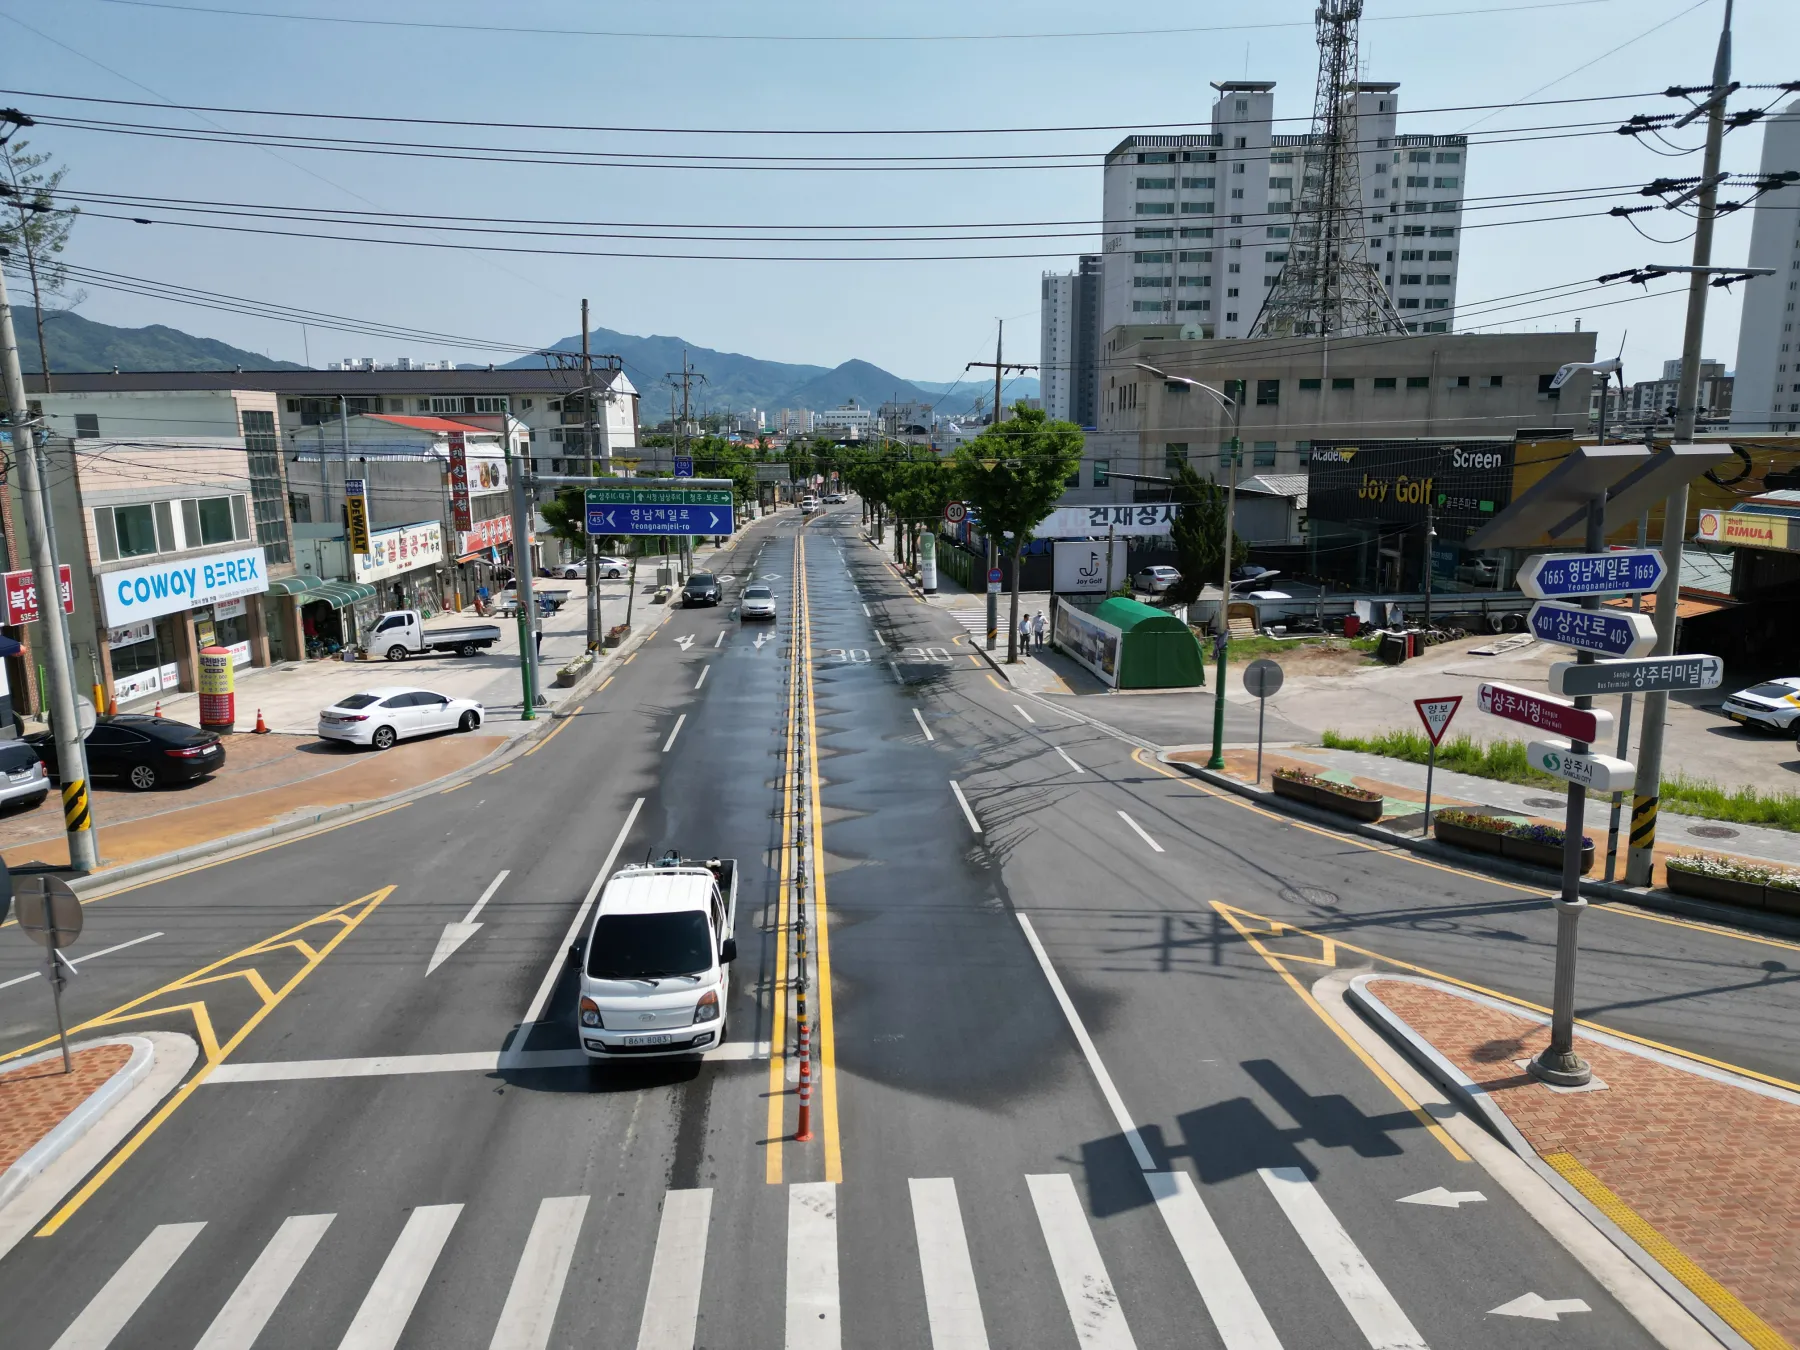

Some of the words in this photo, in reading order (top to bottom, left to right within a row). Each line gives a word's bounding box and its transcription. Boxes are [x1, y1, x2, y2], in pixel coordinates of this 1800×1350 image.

[1453, 448, 1502, 469] Screen
[1358, 473, 1389, 503] Joy
[1395, 475, 1433, 505] Golf
[630, 509, 690, 522] 영남제일로
[949, 507, 962, 517] 30
[631, 523, 690, 531] Yeongnamjeil-ro
[1728, 517, 1743, 526] Shell
[1727, 526, 1773, 540] RIMULA
[203, 557, 259, 589] BEREX
[1544, 570, 1564, 585] 1665
[1568, 558, 1630, 583] 영남제일로
[1634, 564, 1654, 579] 1669
[1568, 581, 1630, 592] Yeongnamjeil-ro
[1537, 615, 1553, 631] 401
[1556, 611, 1607, 637] 상산로
[1610, 629, 1627, 645] 405
[1557, 633, 1604, 649] Sangsan-ro
[826, 648, 872, 662] 30
[904, 647, 953, 662] 30
[1613, 671, 1630, 679] Sangju
[1633, 663, 1700, 688] 상주터미널
[1493, 692, 1541, 723] 상주시청
[1428, 714, 1447, 722] YIELD
[1563, 757, 1593, 777] 상주시
[1581, 775, 1592, 784] CITY
